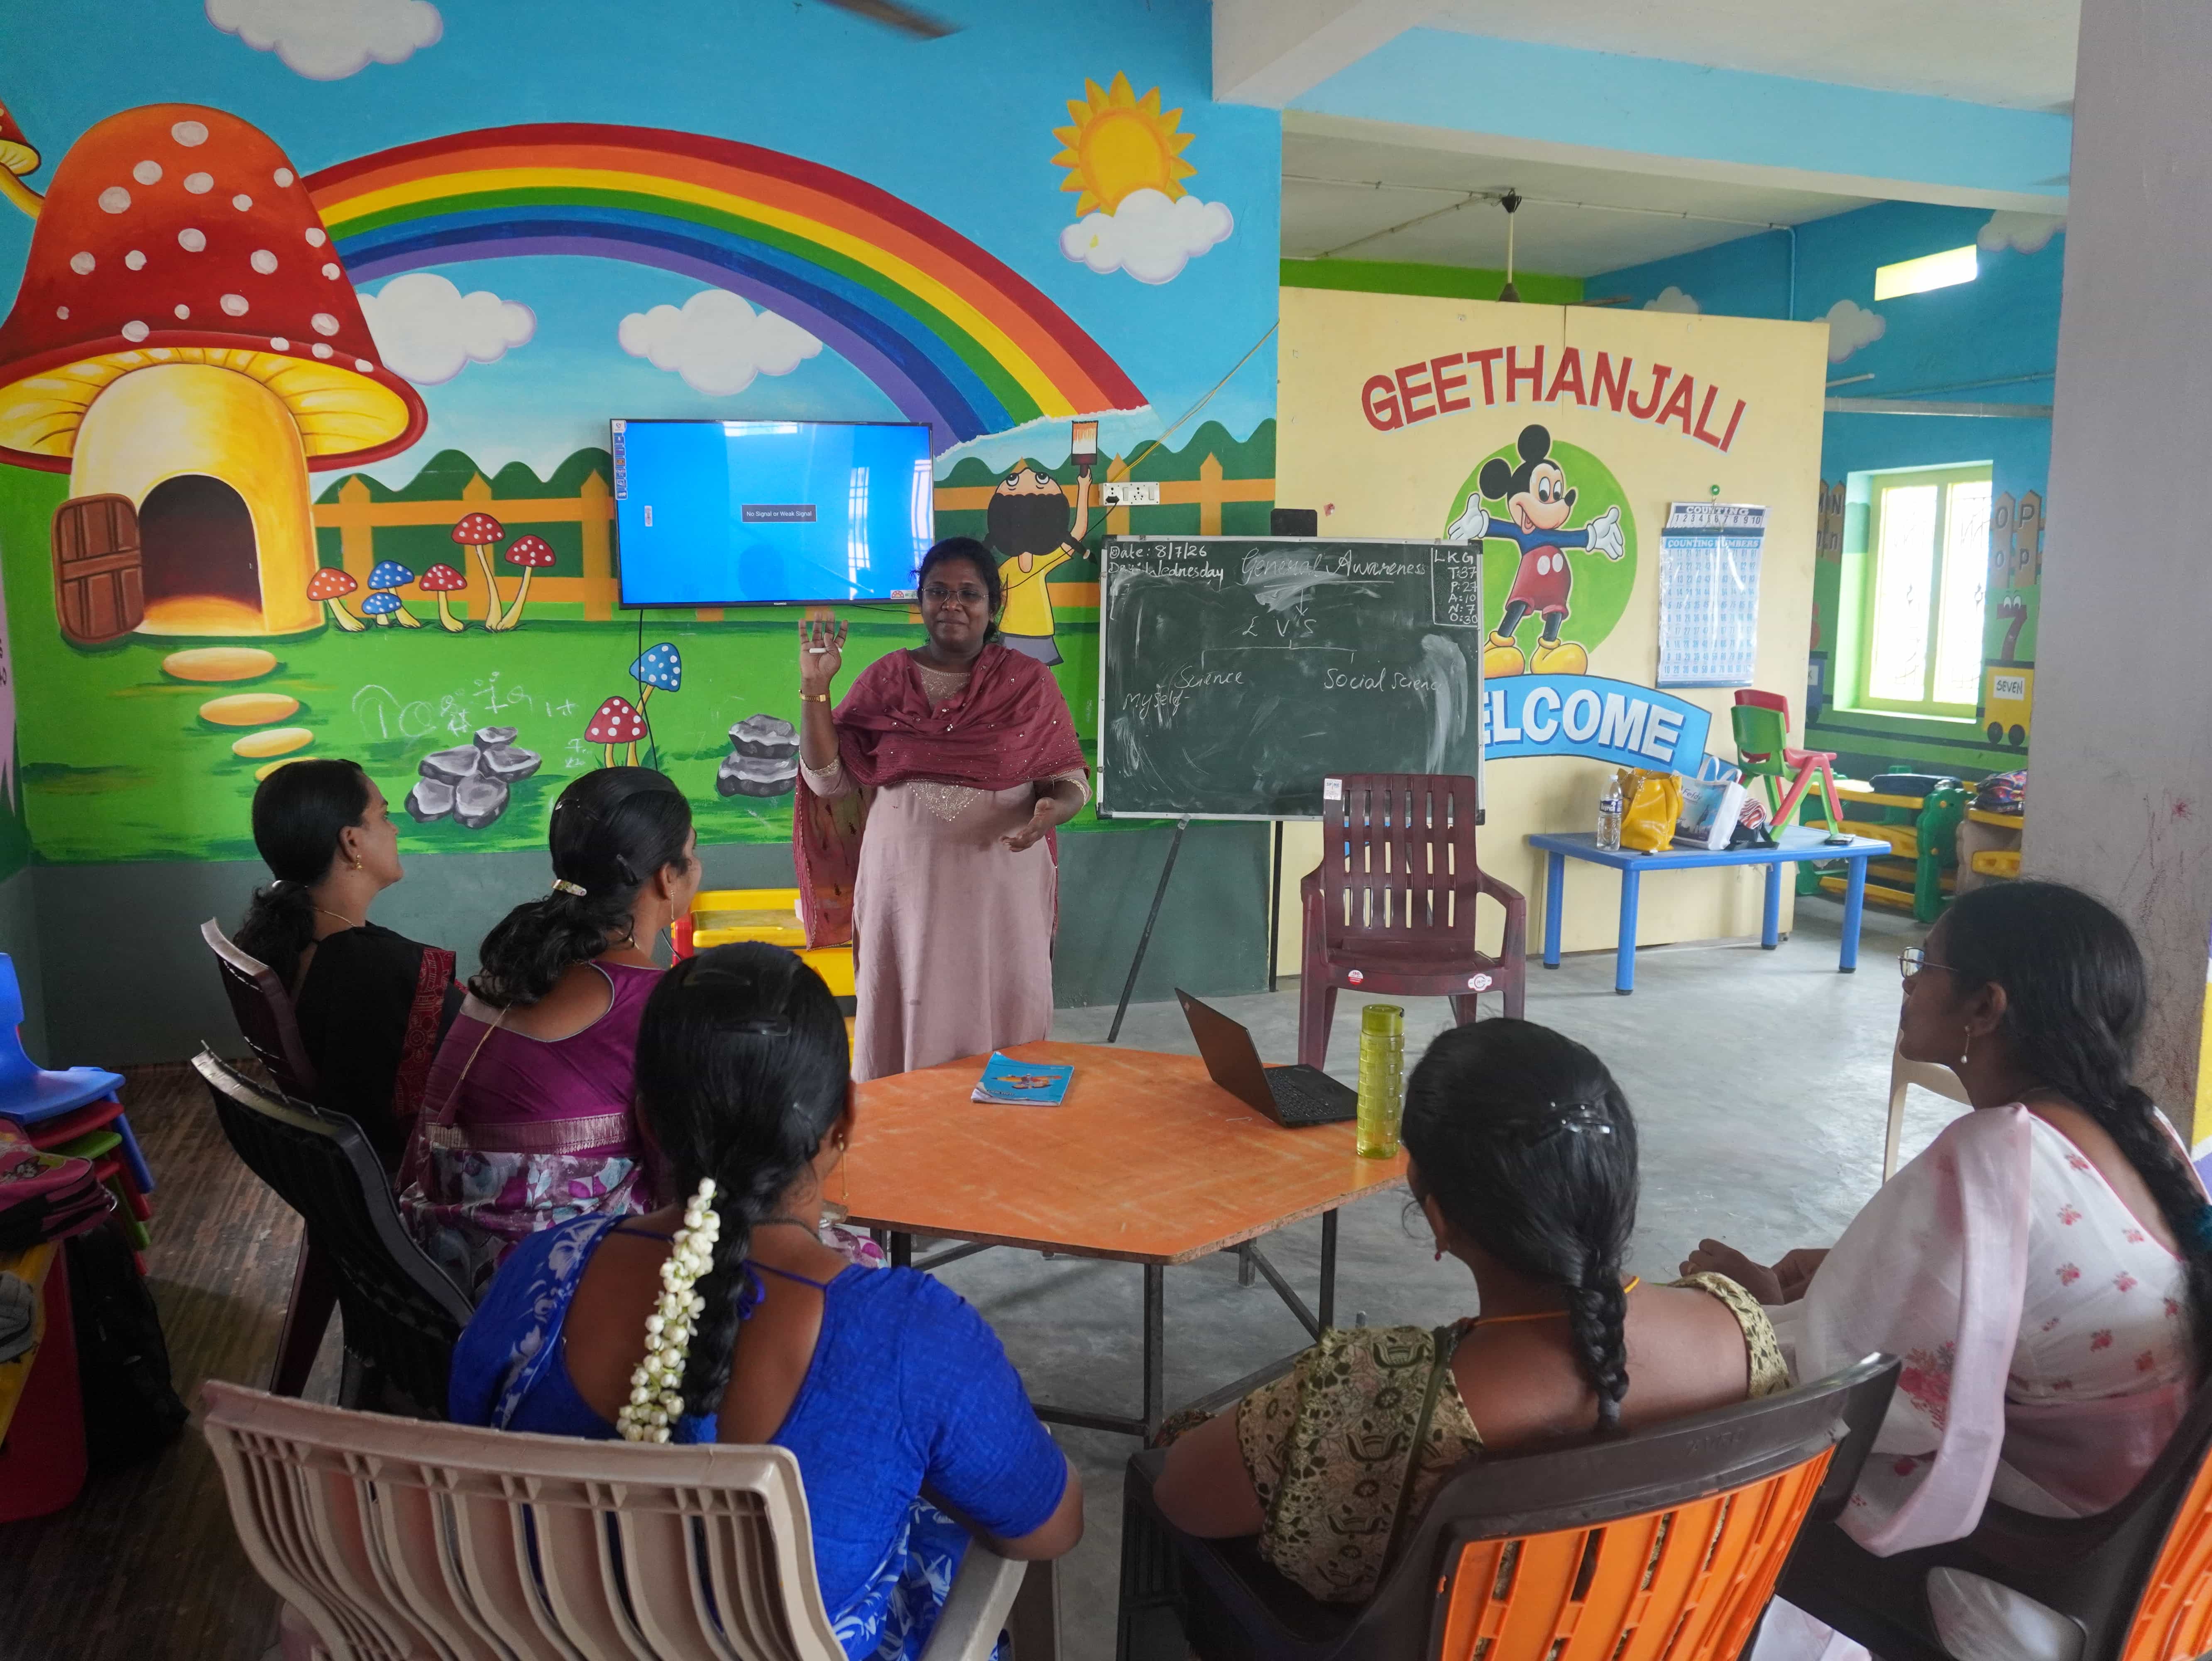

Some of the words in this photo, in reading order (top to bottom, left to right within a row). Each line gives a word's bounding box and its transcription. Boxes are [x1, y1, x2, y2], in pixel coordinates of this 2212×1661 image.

[1361, 345, 1746, 453] GEETHANJALI
[1686, 507, 1750, 515] COUNTING
[2019, 504, 2034, 529] P
[1155, 542, 1207, 560] 8/7/26
[1145, 560, 1224, 591] Wednesday
[1236, 546, 1325, 586] General
[1326, 549, 1426, 576] Awareness
[1174, 665, 1244, 688] Science
[1324, 667, 1386, 692] Social
[1996, 679, 2023, 695] SEVEN
[1484, 686, 1686, 765] LCOME
